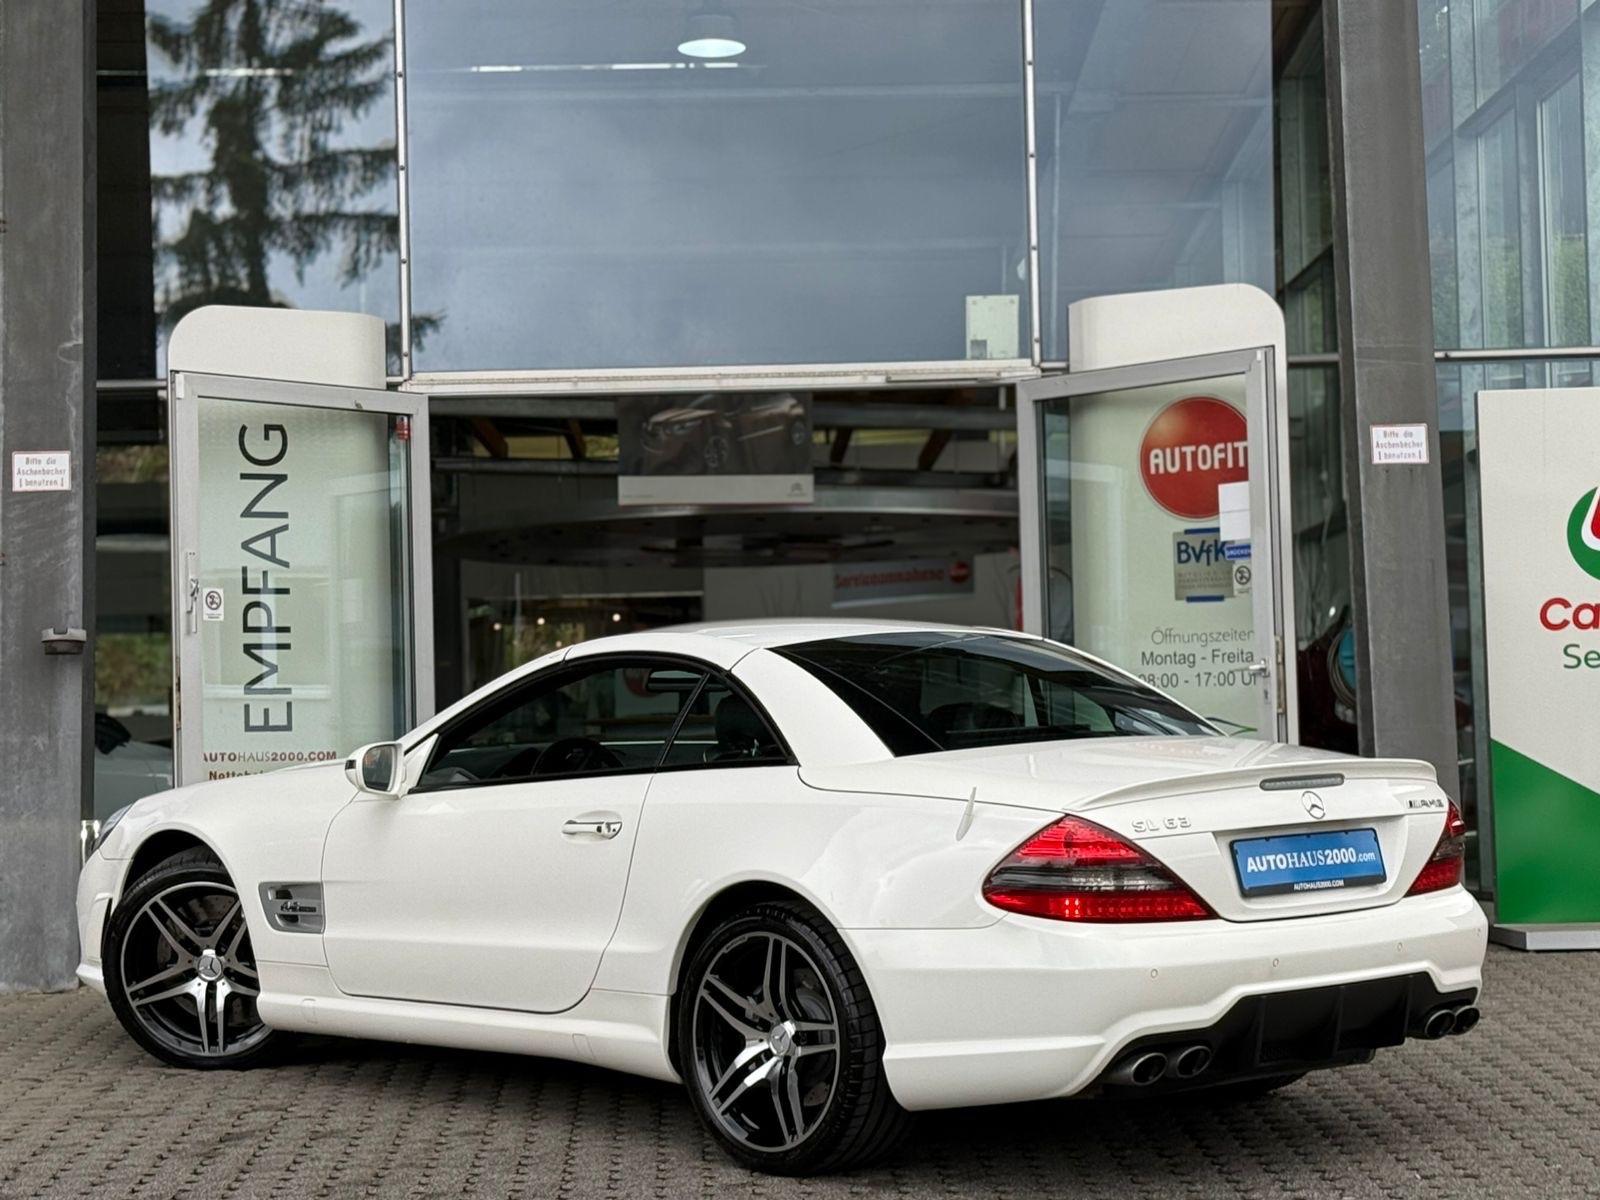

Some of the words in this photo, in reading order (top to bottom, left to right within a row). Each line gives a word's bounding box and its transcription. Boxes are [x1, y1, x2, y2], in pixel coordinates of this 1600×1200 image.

[1149, 440, 1248, 475] AUTOFIT
[1176, 539, 1226, 567] BvfK
[239, 423, 293, 733] EMPFANG
[1539, 597, 1600, 631] Ca
[1141, 650, 1196, 668] Montag
[1563, 643, 1600, 669] Se
[1195, 670, 1236, 687] 17:00
[1131, 818, 1160, 833] SL
[1163, 816, 1192, 830] 63
[1246, 846, 1376, 873] AUTOHAUS2000.com
